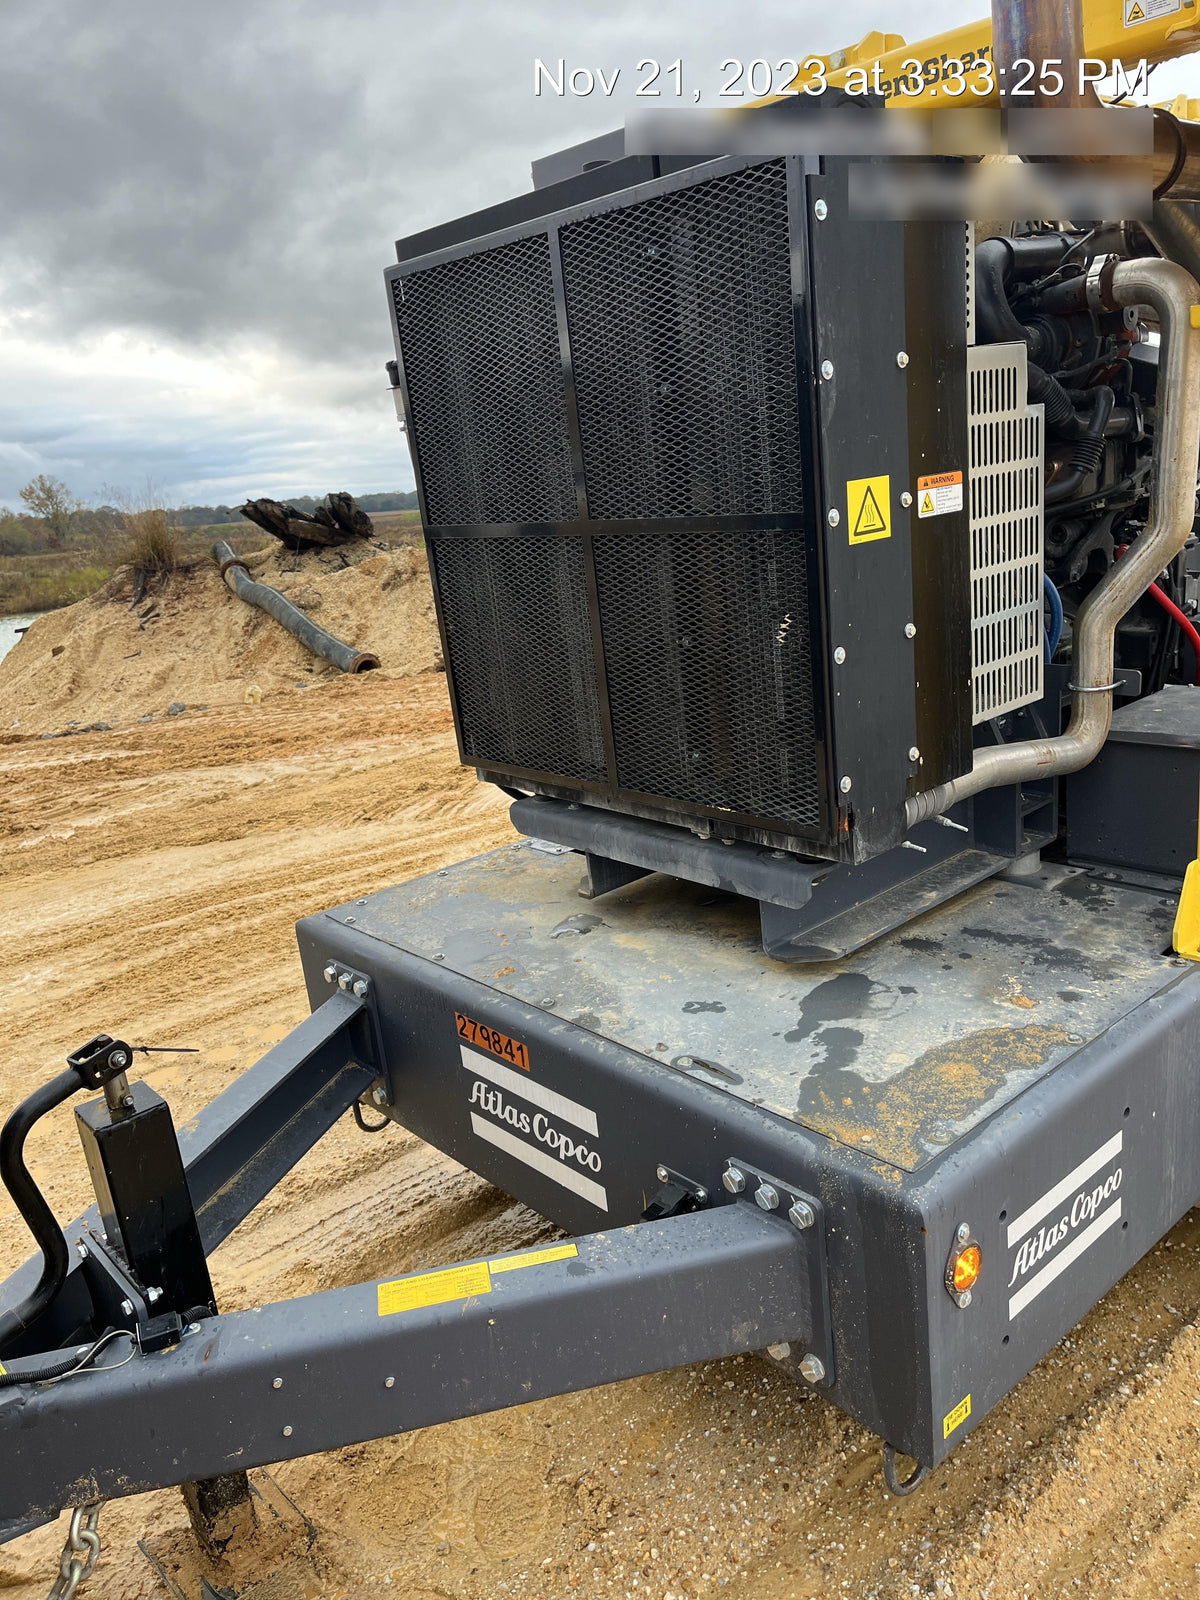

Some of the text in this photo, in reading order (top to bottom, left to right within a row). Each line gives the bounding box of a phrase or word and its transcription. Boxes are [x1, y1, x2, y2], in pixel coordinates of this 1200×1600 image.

[930, 474, 955, 485] WARNING
[456, 1014, 526, 1068] 279841
[467, 1080, 603, 1174] Atlas Copco
[1007, 1166, 1124, 1288] Atlas Copco
